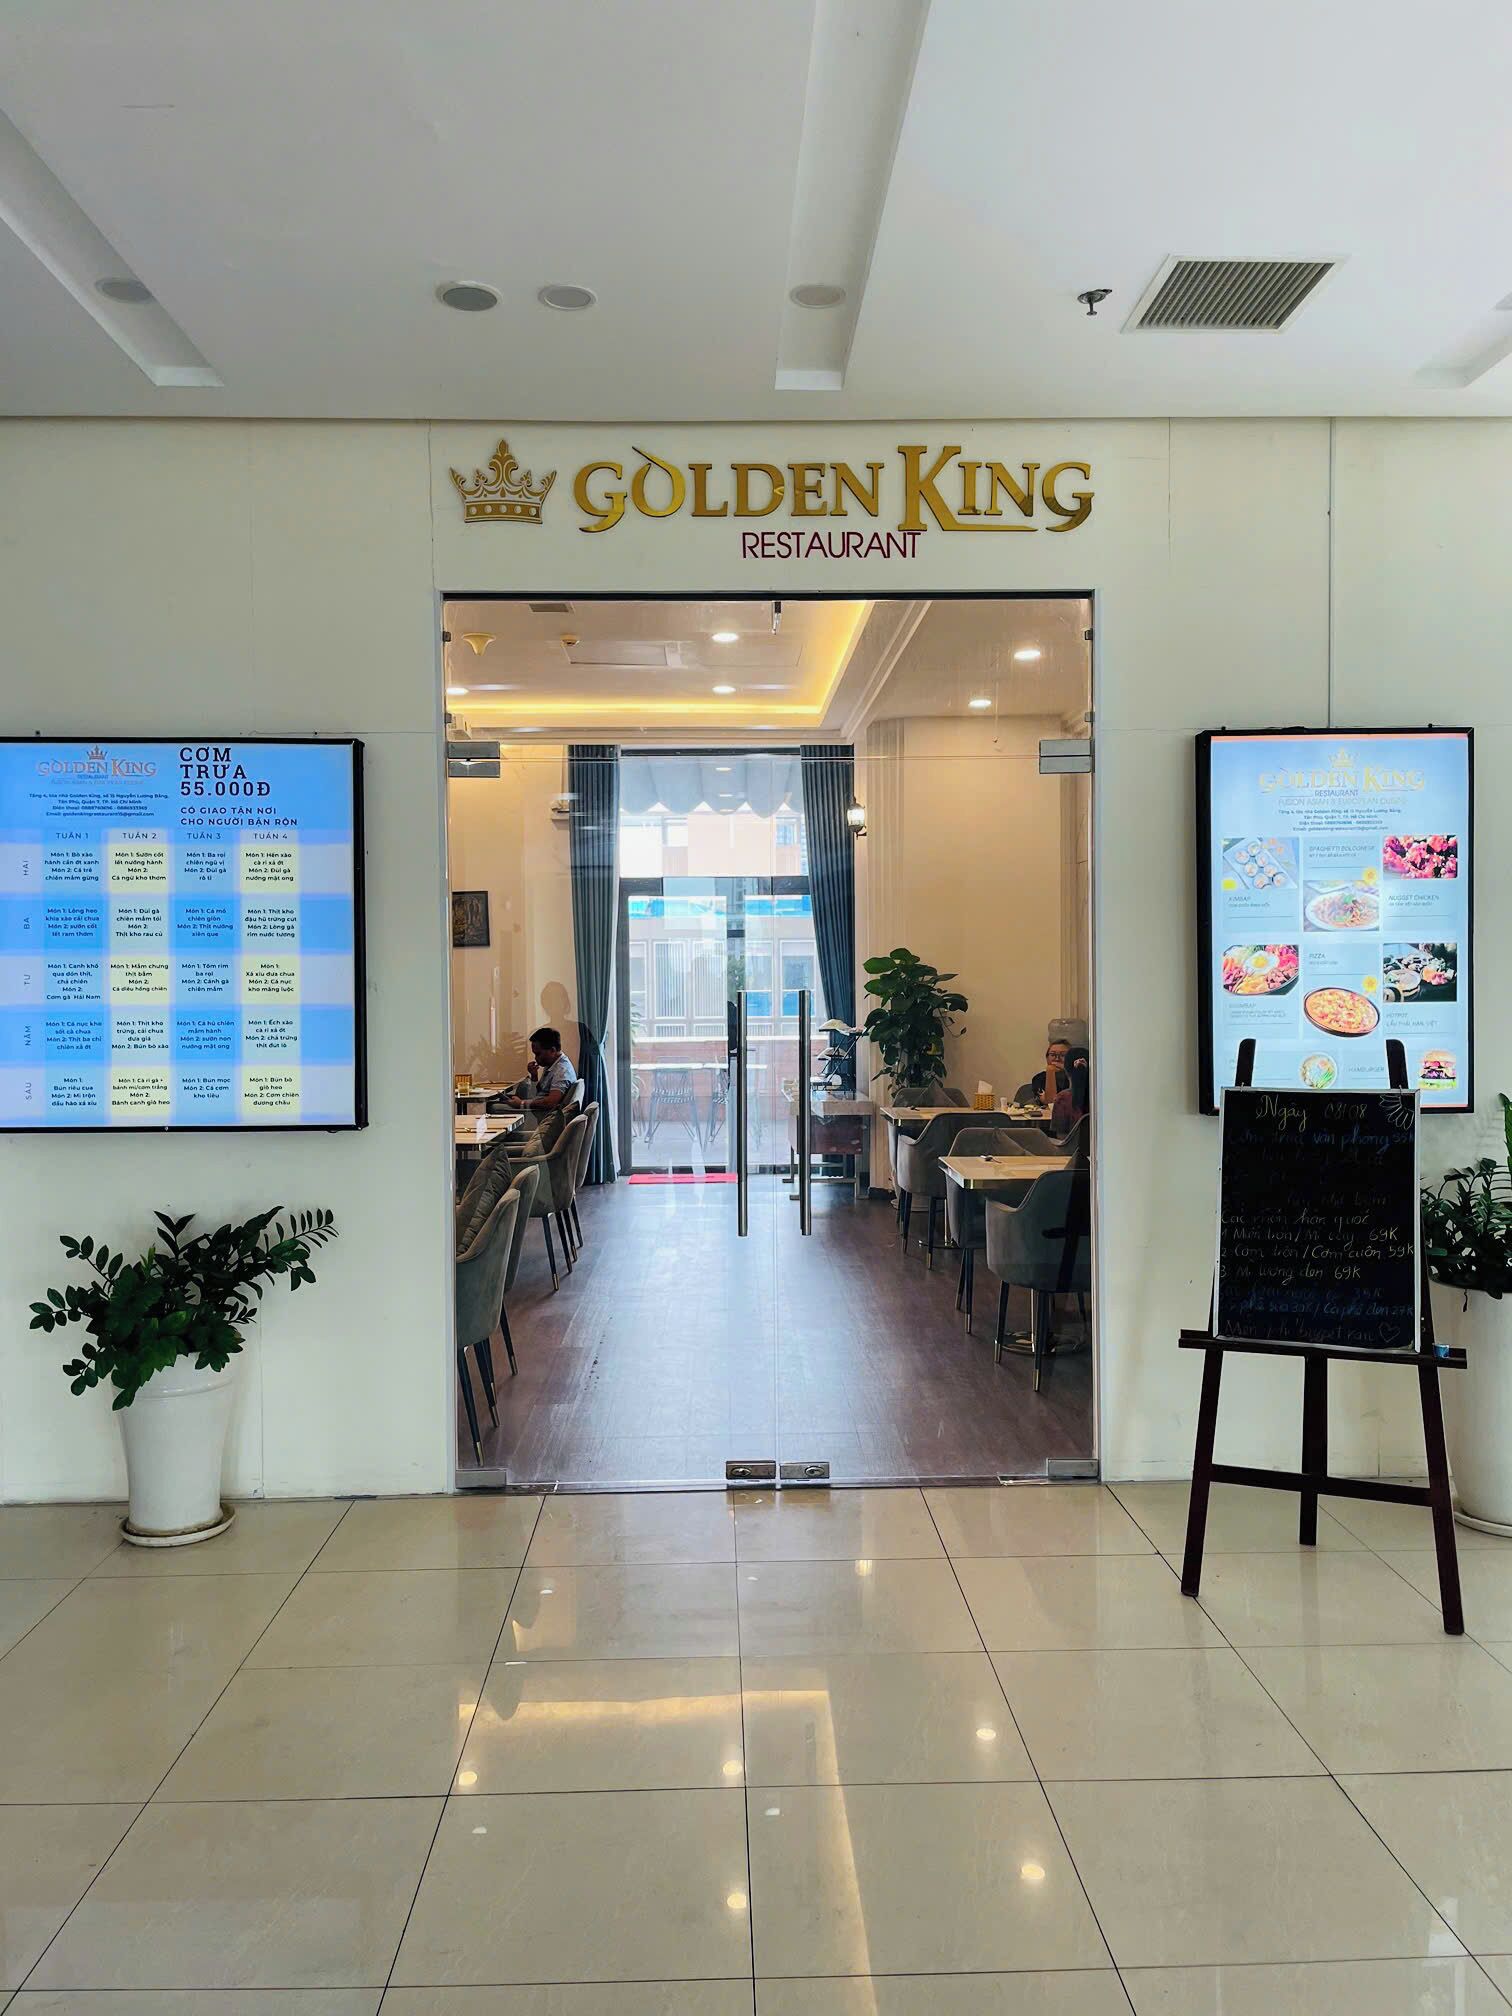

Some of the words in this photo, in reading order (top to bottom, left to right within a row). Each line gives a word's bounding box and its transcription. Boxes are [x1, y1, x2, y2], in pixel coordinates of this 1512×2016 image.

[573, 446, 884, 533] GOLDEN
[897, 444, 1094, 533] KING
[741, 531, 921, 559] RESTAURANT
[180, 747, 231, 762] CƠM
[38, 758, 108, 776] GOLDEN
[111, 758, 156, 777] KING
[180, 764, 247, 779] TRƯA
[1259, 768, 1357, 794] GOLDEN
[1363, 766, 1424, 792] KING
[180, 781, 270, 796] 55.000Đ
[1314, 789, 1359, 797] RESTAURANT
[180, 806, 196, 814] CÓ
[180, 818, 204, 826] CHO
[208, 817, 243, 826] NGƯỜI
[248, 818, 270, 828] BẬN
[23, 917, 30, 930] BA
